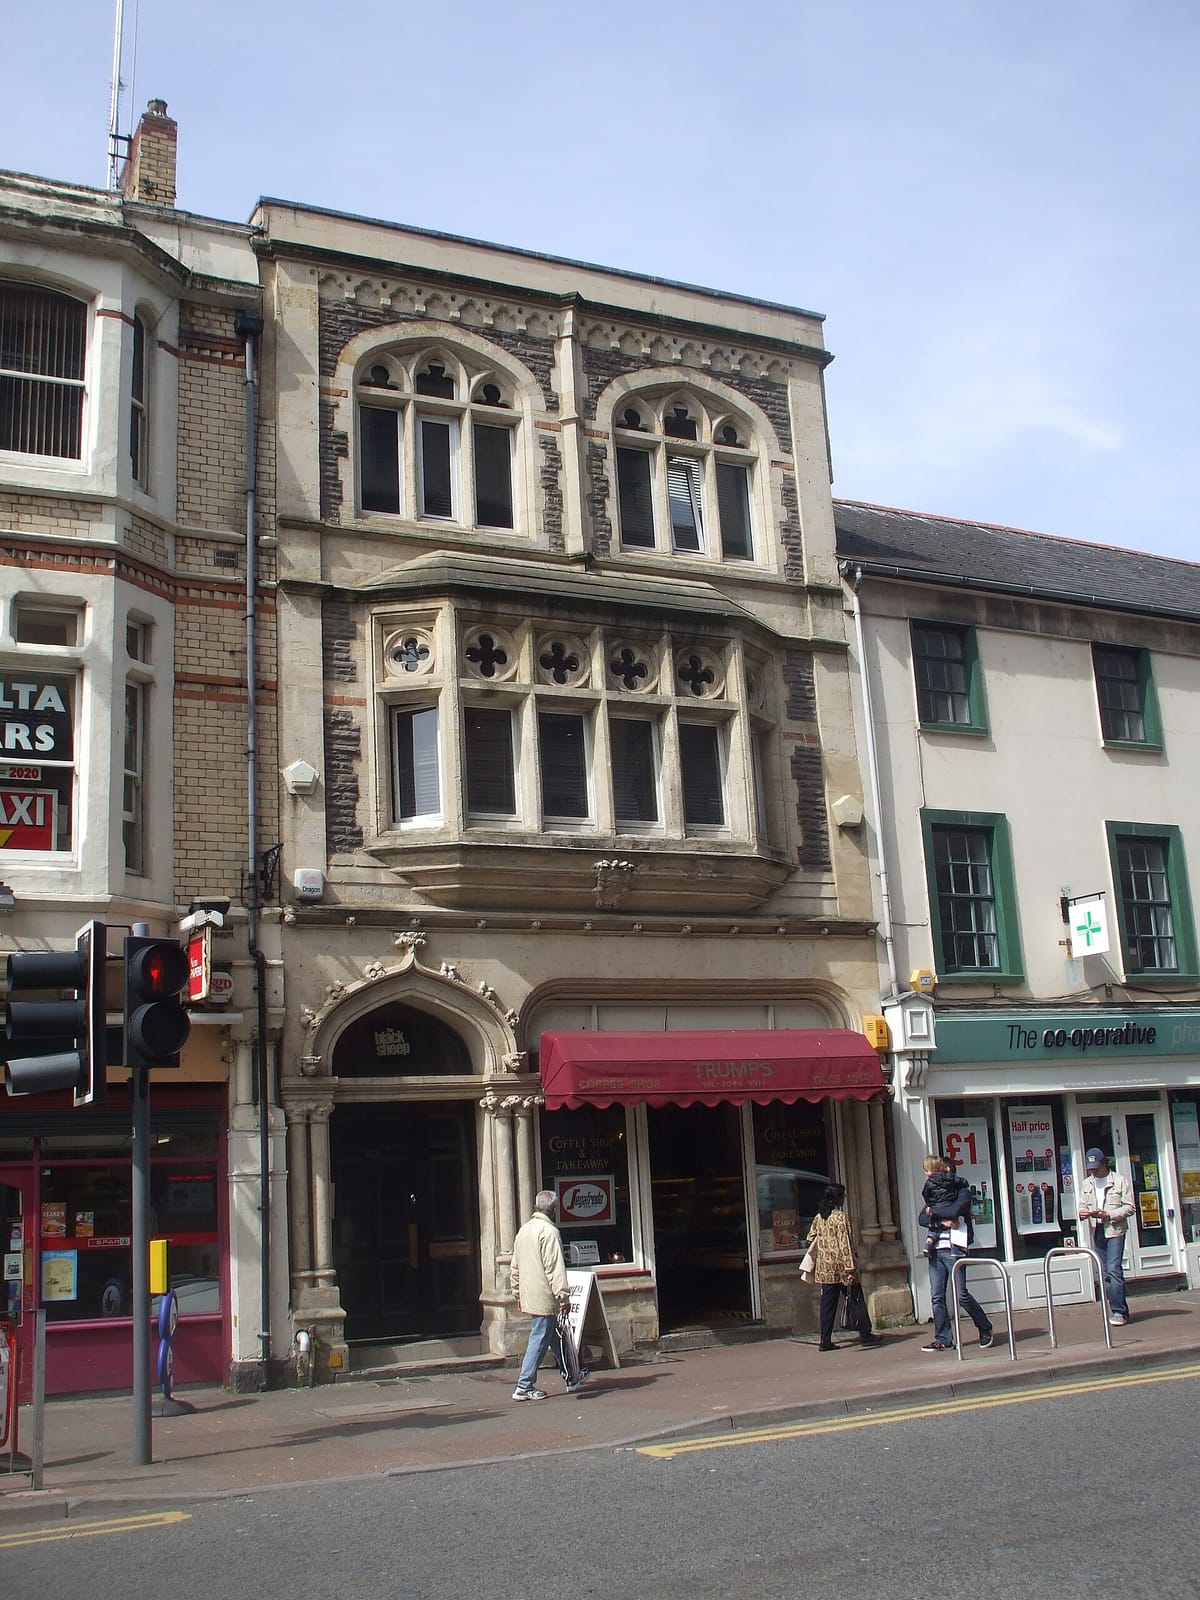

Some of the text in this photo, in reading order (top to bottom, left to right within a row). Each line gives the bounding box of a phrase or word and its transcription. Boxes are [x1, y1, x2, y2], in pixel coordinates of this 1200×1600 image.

[9, 767, 39, 779] 2020
[1007, 1025, 1037, 1048] The
[1042, 1021, 1156, 1052] co-operative
[376, 1042, 411, 1056] sheep
[692, 1061, 773, 1079] TRUMPS
[579, 1079, 660, 1089] COFFEE SHOP
[1011, 1120, 1050, 1134] Half price
[549, 1136, 587, 1152] COFFEE
[945, 1132, 977, 1167] £1
